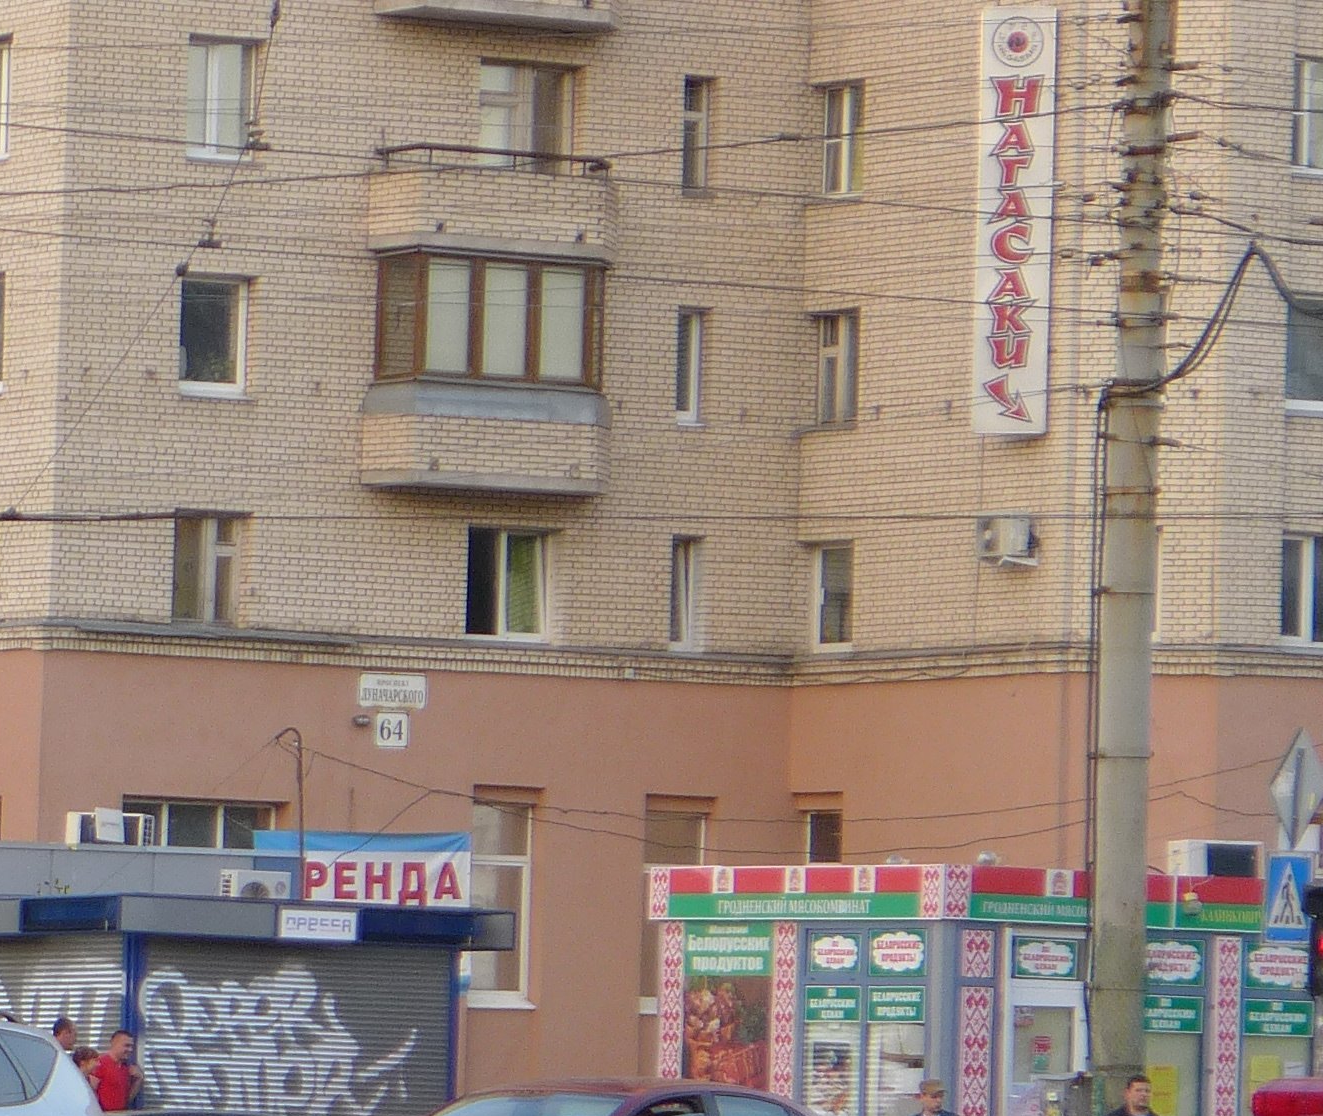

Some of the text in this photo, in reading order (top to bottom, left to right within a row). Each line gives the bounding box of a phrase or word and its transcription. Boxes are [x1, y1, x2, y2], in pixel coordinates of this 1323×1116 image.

[986, 75, 1045, 369] НАГАСАКИ
[361, 688, 424, 703] ЛУНАЧАРСКОГО
[380, 718, 404, 741] 64
[718, 897, 786, 914] ГРОДНЕНСКИЙ
